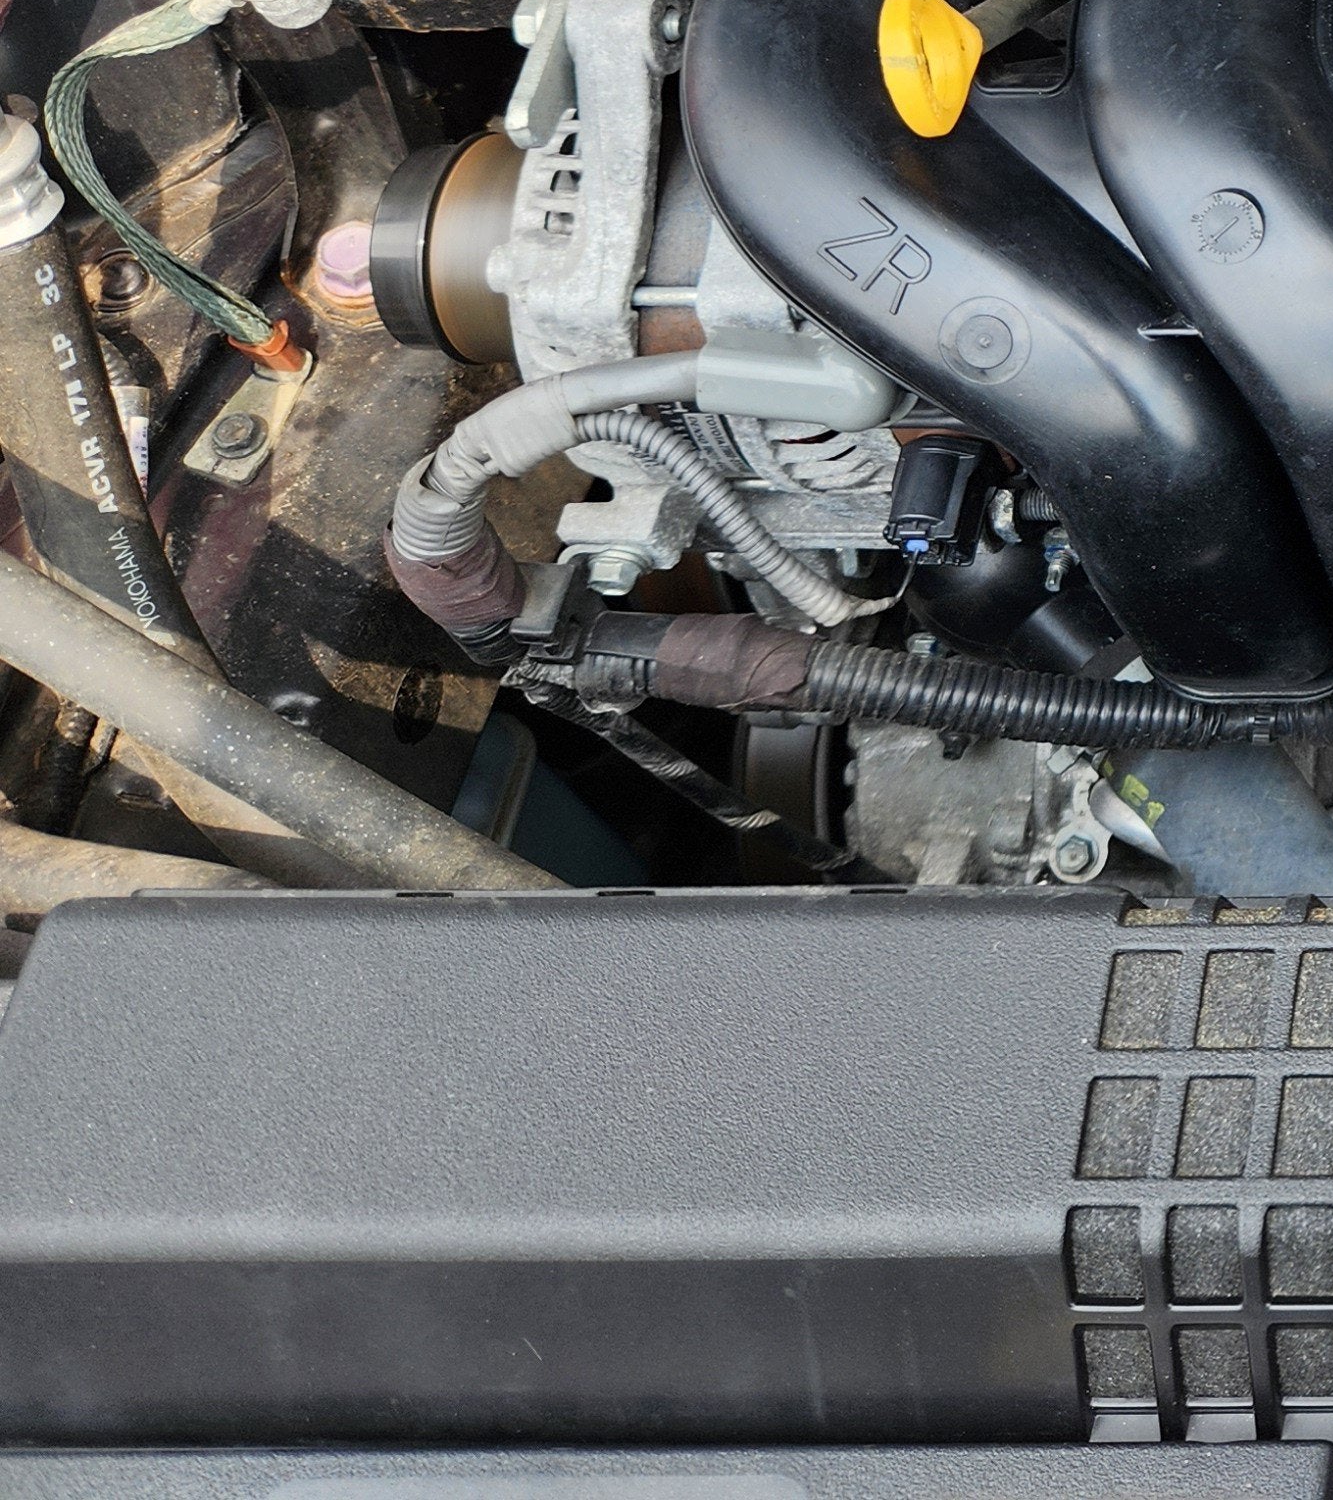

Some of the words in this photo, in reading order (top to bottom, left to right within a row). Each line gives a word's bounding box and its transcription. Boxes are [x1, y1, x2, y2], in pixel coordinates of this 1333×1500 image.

[34, 262, 62, 308] 3C
[816, 195, 932, 315] ZR
[51, 333, 76, 372] LP
[79, 434, 117, 515] ACVR
[107, 527, 163, 628] YOKOHAMA
